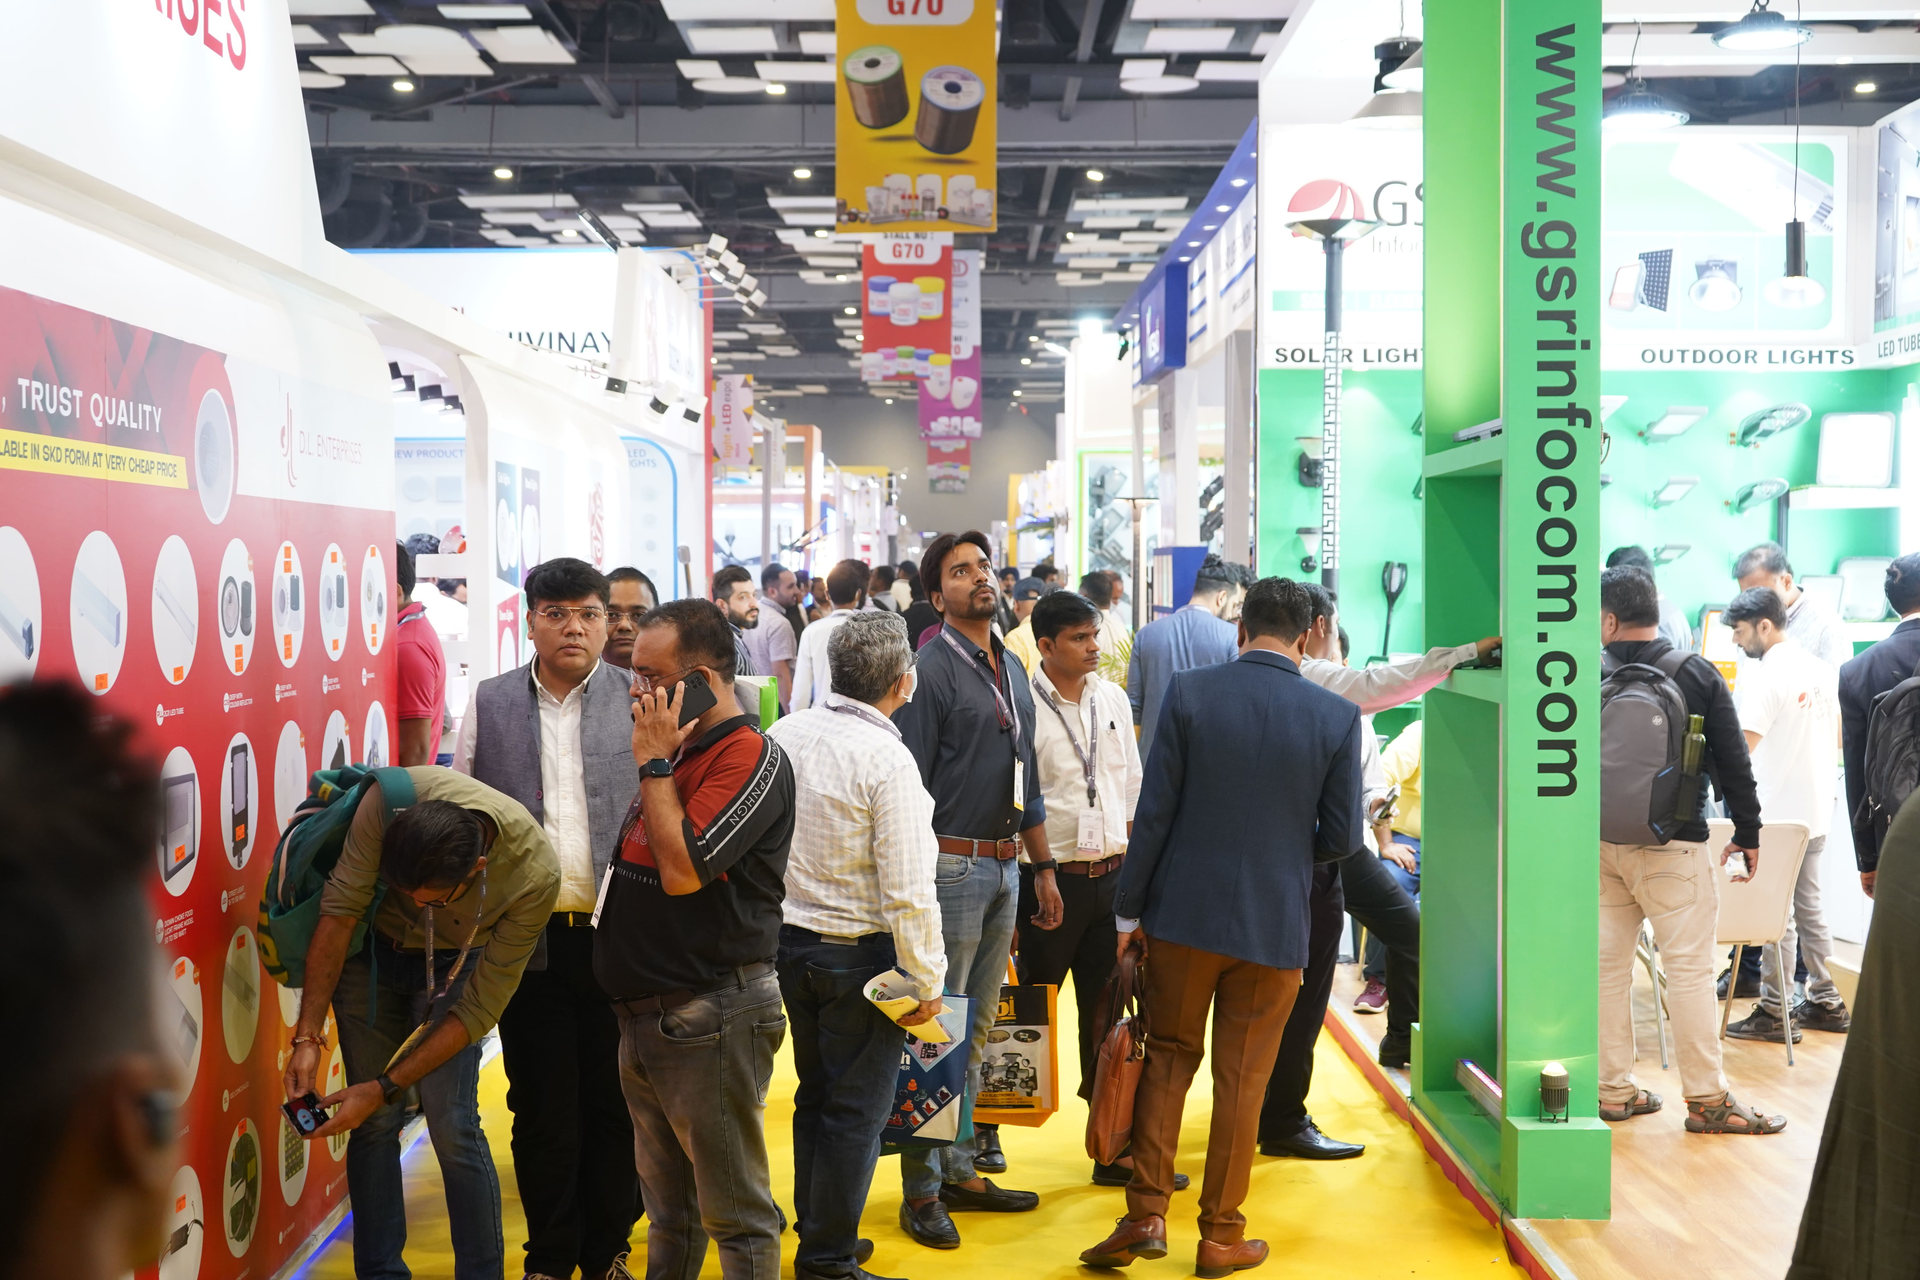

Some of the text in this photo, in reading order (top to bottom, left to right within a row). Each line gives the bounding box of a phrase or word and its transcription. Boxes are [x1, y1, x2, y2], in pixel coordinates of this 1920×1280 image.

[887, 0, 943, 15] G70
[892, 243, 924, 259] G70
[1363, 347, 1423, 363] LIGH
[1641, 348, 1855, 365] OUTDOOR LIGHTS
[1877, 340, 1895, 359] LED
[17, 377, 162, 433] TRUST QUALITY
[722, 403, 732, 425] LED
[1520, 23, 1591, 798] www.gsrinfocom.com
[316, 434, 362, 465] ENTERPRISES
[627, 448, 647, 458] LED
[30, 443, 40, 460] IN
[42, 444, 62, 463] SKD
[64, 448, 90, 467] FORM
[92, 451, 103, 468] AT
[105, 455, 127, 472] VERY
[128, 457, 155, 475] CHEAP
[156, 462, 177, 478] PRICE
